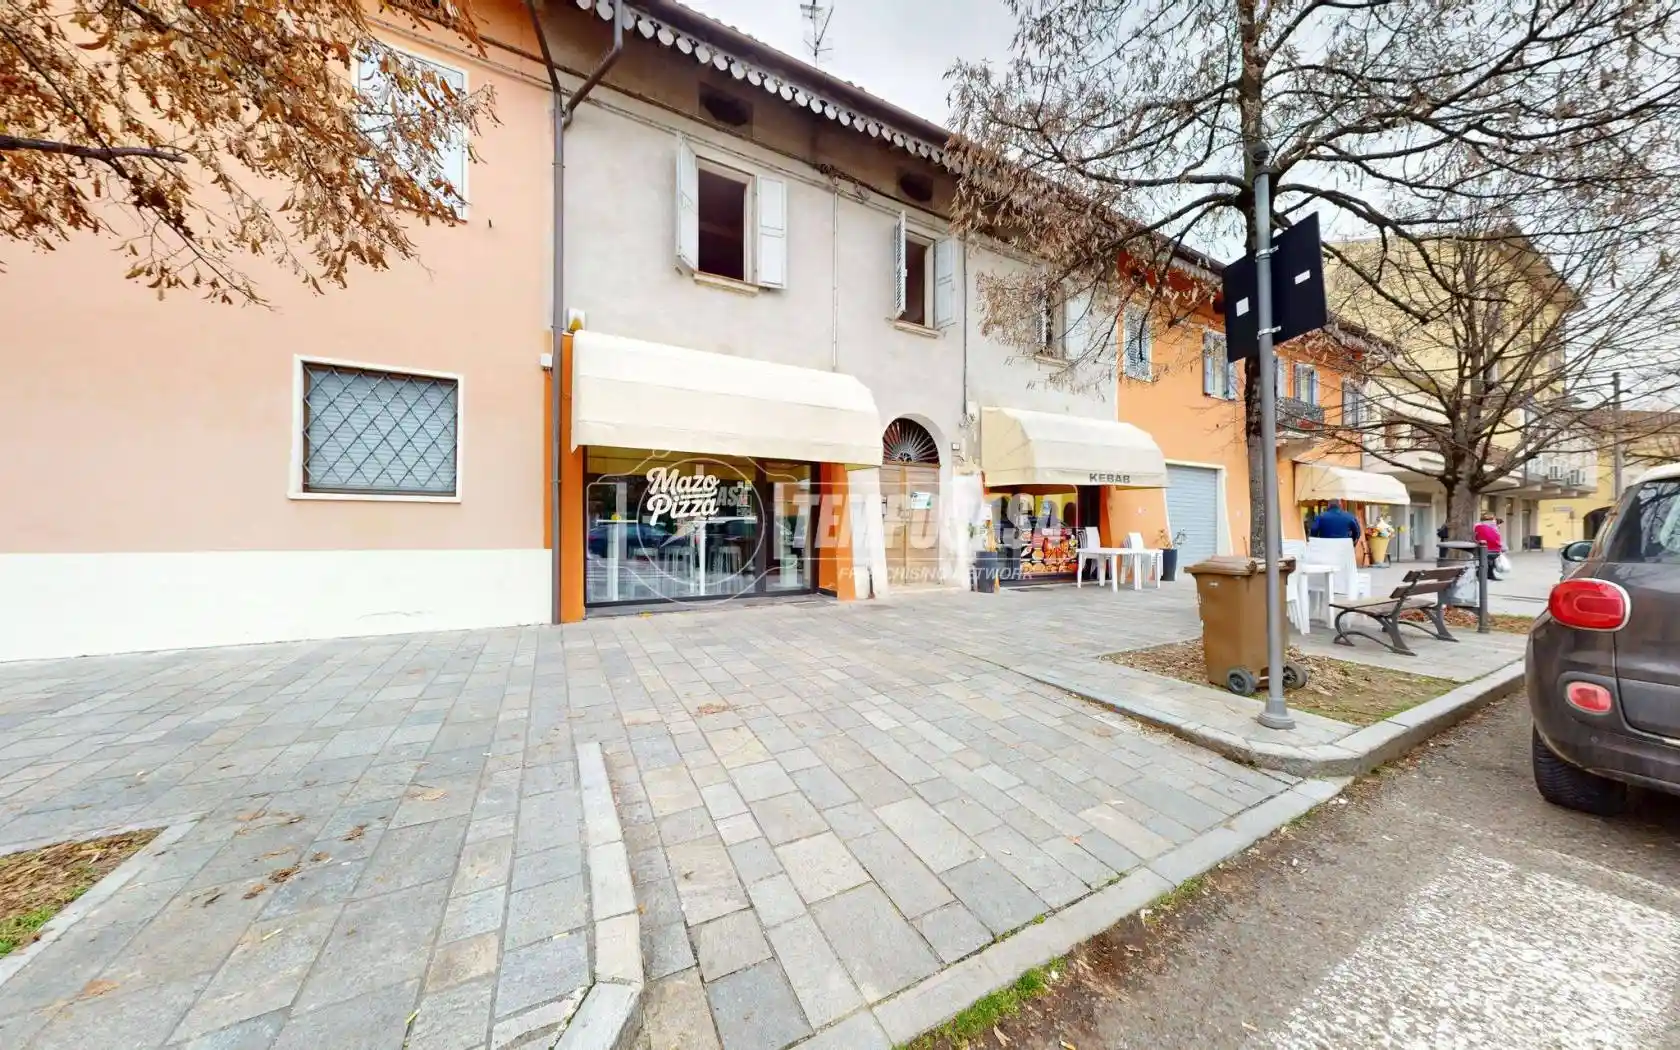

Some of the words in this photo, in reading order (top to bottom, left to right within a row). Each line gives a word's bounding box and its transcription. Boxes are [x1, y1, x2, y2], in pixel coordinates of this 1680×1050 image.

[646, 466, 719, 497] Mazo
[1089, 473, 1131, 484] KEBAB
[646, 494, 719, 527] Pizza
